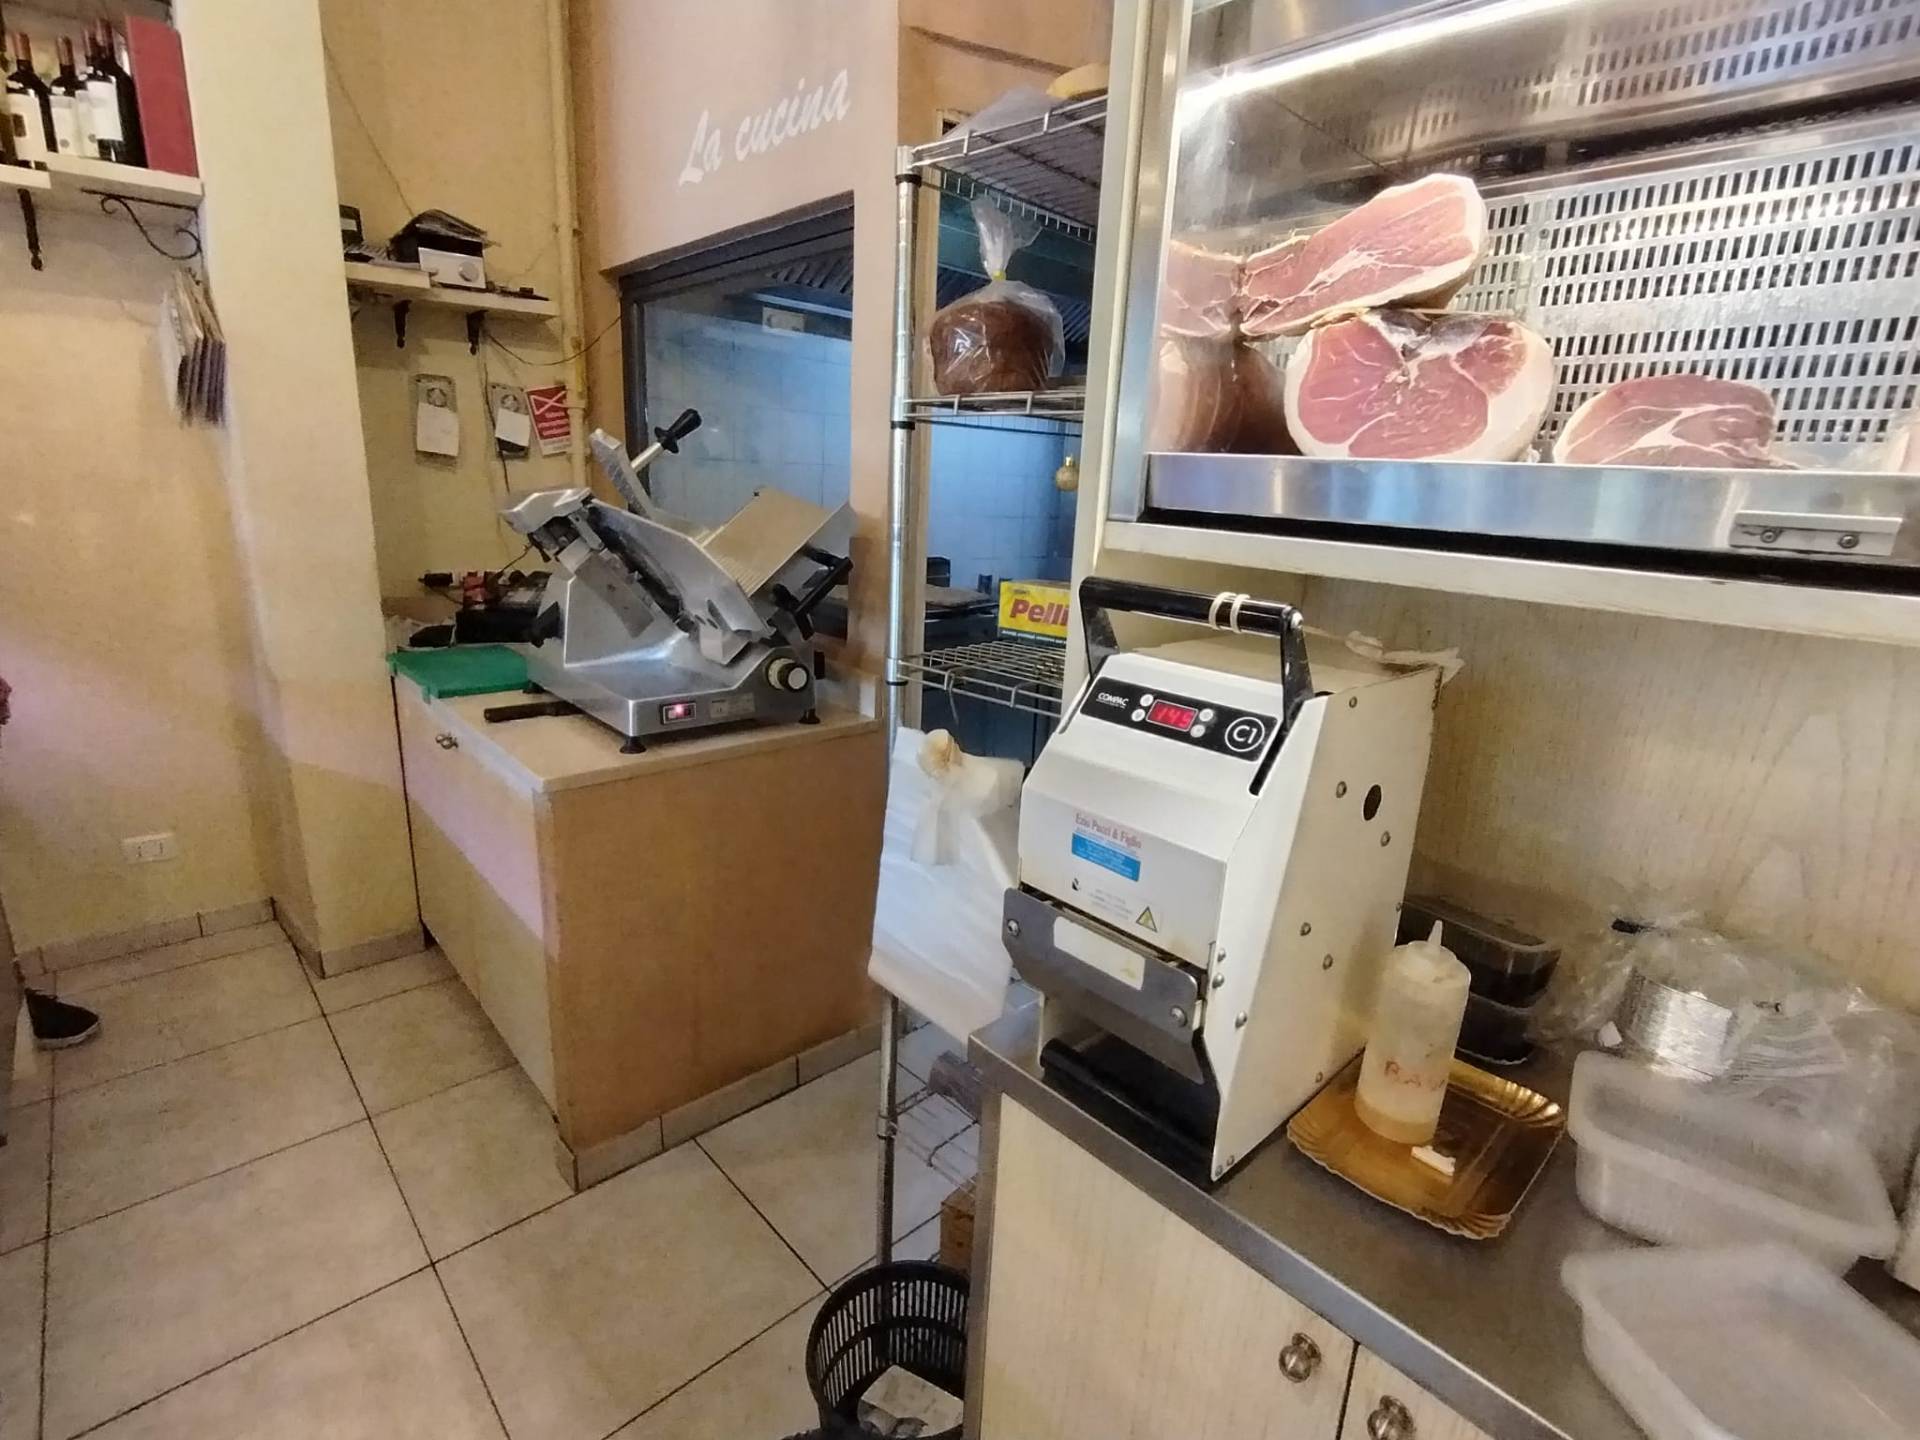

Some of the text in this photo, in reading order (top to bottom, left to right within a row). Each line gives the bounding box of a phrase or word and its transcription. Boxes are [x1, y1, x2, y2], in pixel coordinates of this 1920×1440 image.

[678, 67, 851, 188] La cucina
[1097, 691, 1130, 707] COMPAC
[1232, 724, 1258, 745] C1
